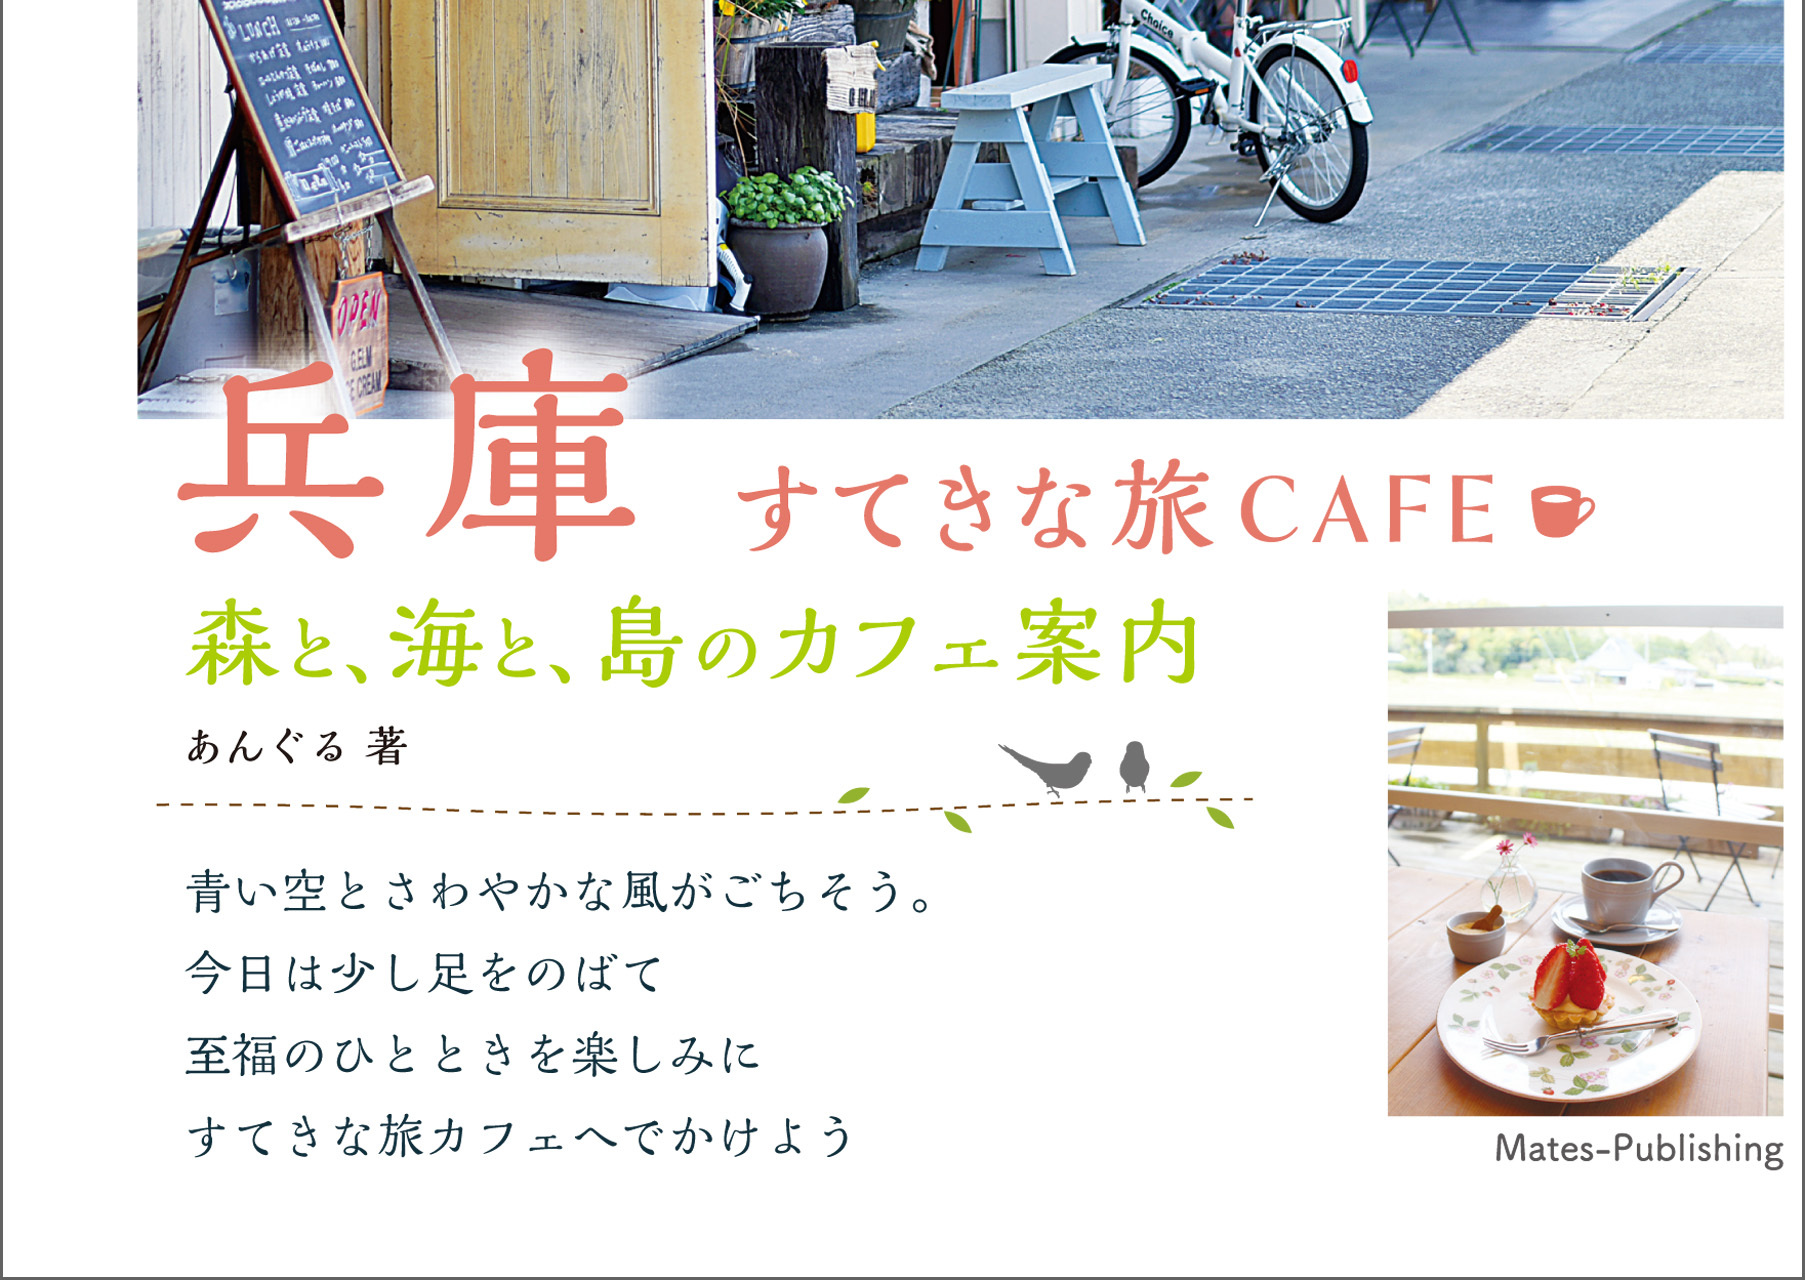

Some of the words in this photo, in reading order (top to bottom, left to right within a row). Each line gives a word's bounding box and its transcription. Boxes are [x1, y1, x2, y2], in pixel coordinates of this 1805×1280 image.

[238, 15, 281, 41] LUNCH
[1140, 8, 1174, 39] Choice
[337, 289, 382, 336] OPEN
[357, 370, 382, 399] CREAM
